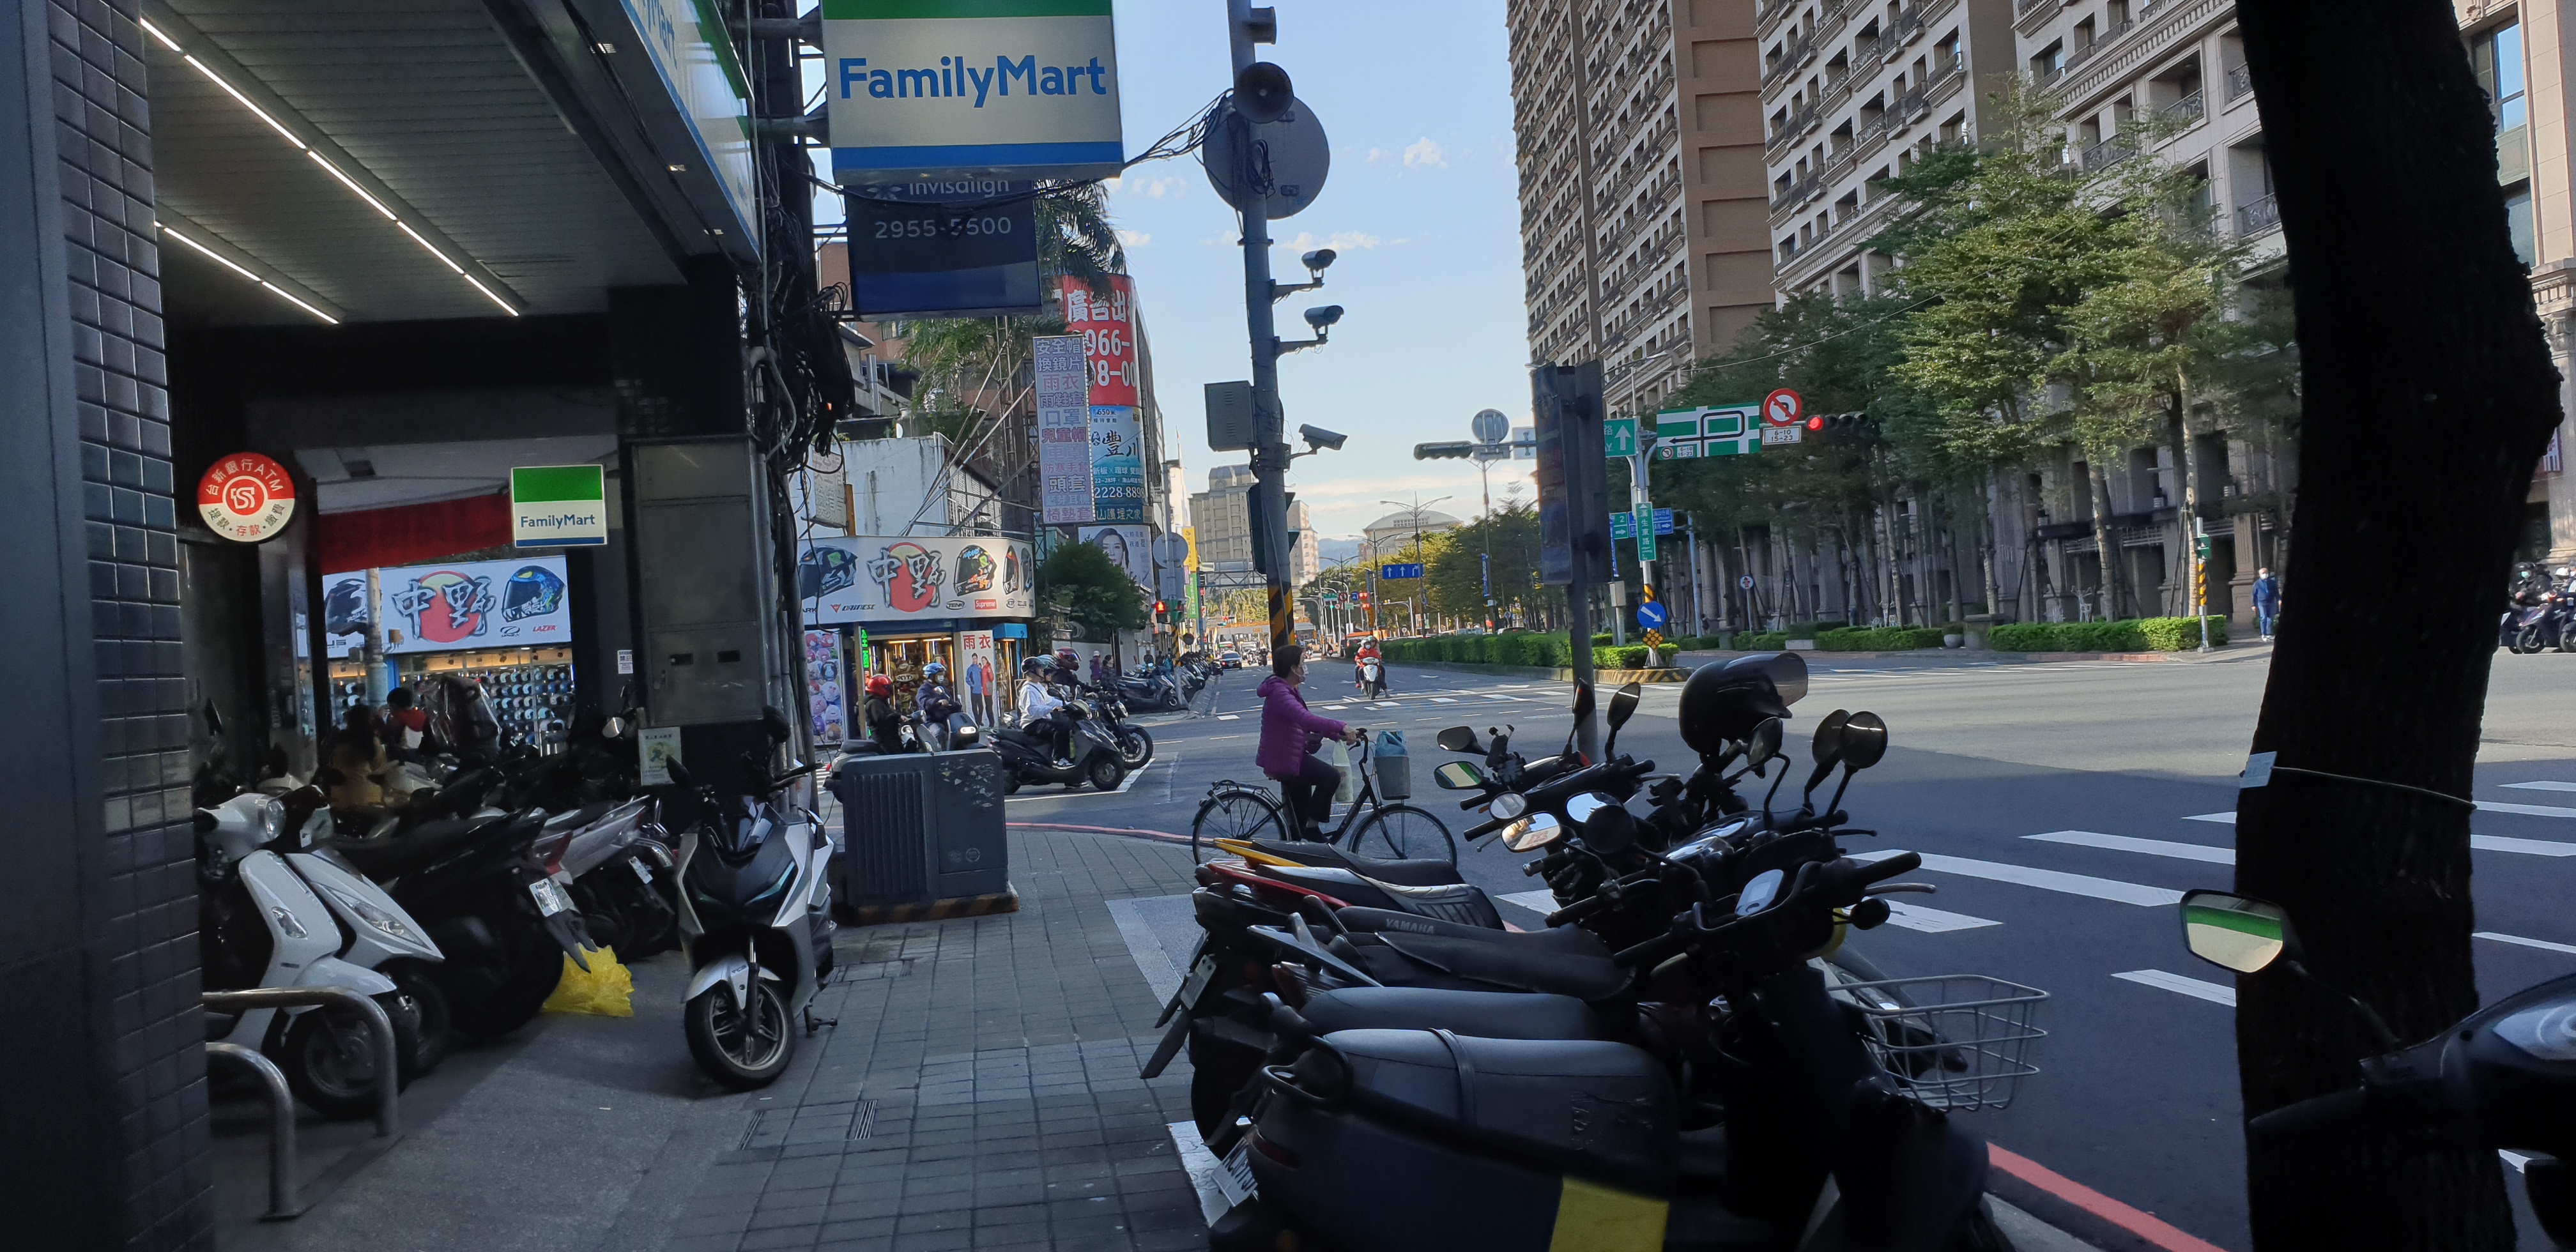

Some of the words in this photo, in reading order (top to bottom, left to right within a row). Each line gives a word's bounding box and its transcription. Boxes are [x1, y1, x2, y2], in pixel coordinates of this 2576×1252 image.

[839, 55, 1107, 107] FamilyMart
[1067, 289, 1131, 323] 廣告出
[1036, 338, 1082, 356] 安全帽
[1084, 329, 1130, 356] 966-
[1038, 356, 1082, 372] 換鏡片
[1042, 373, 1079, 392] 雨衣
[1039, 392, 1085, 408] 雨鞋套
[1045, 409, 1080, 426] 口罩
[1041, 427, 1087, 443] 兒童帽
[1044, 461, 1089, 474] 防寒手套
[1048, 475, 1085, 494] 頭套
[1094, 486, 1146, 498] 2228-8898
[521, 514, 595, 529] FamilyMart
[1046, 507, 1091, 522] 椅墊套
[867, 547, 946, 609] 中野
[391, 575, 496, 639] 中野
[963, 634, 991, 650] 雨衣
[1386, 918, 1434, 934] YAMAHA
